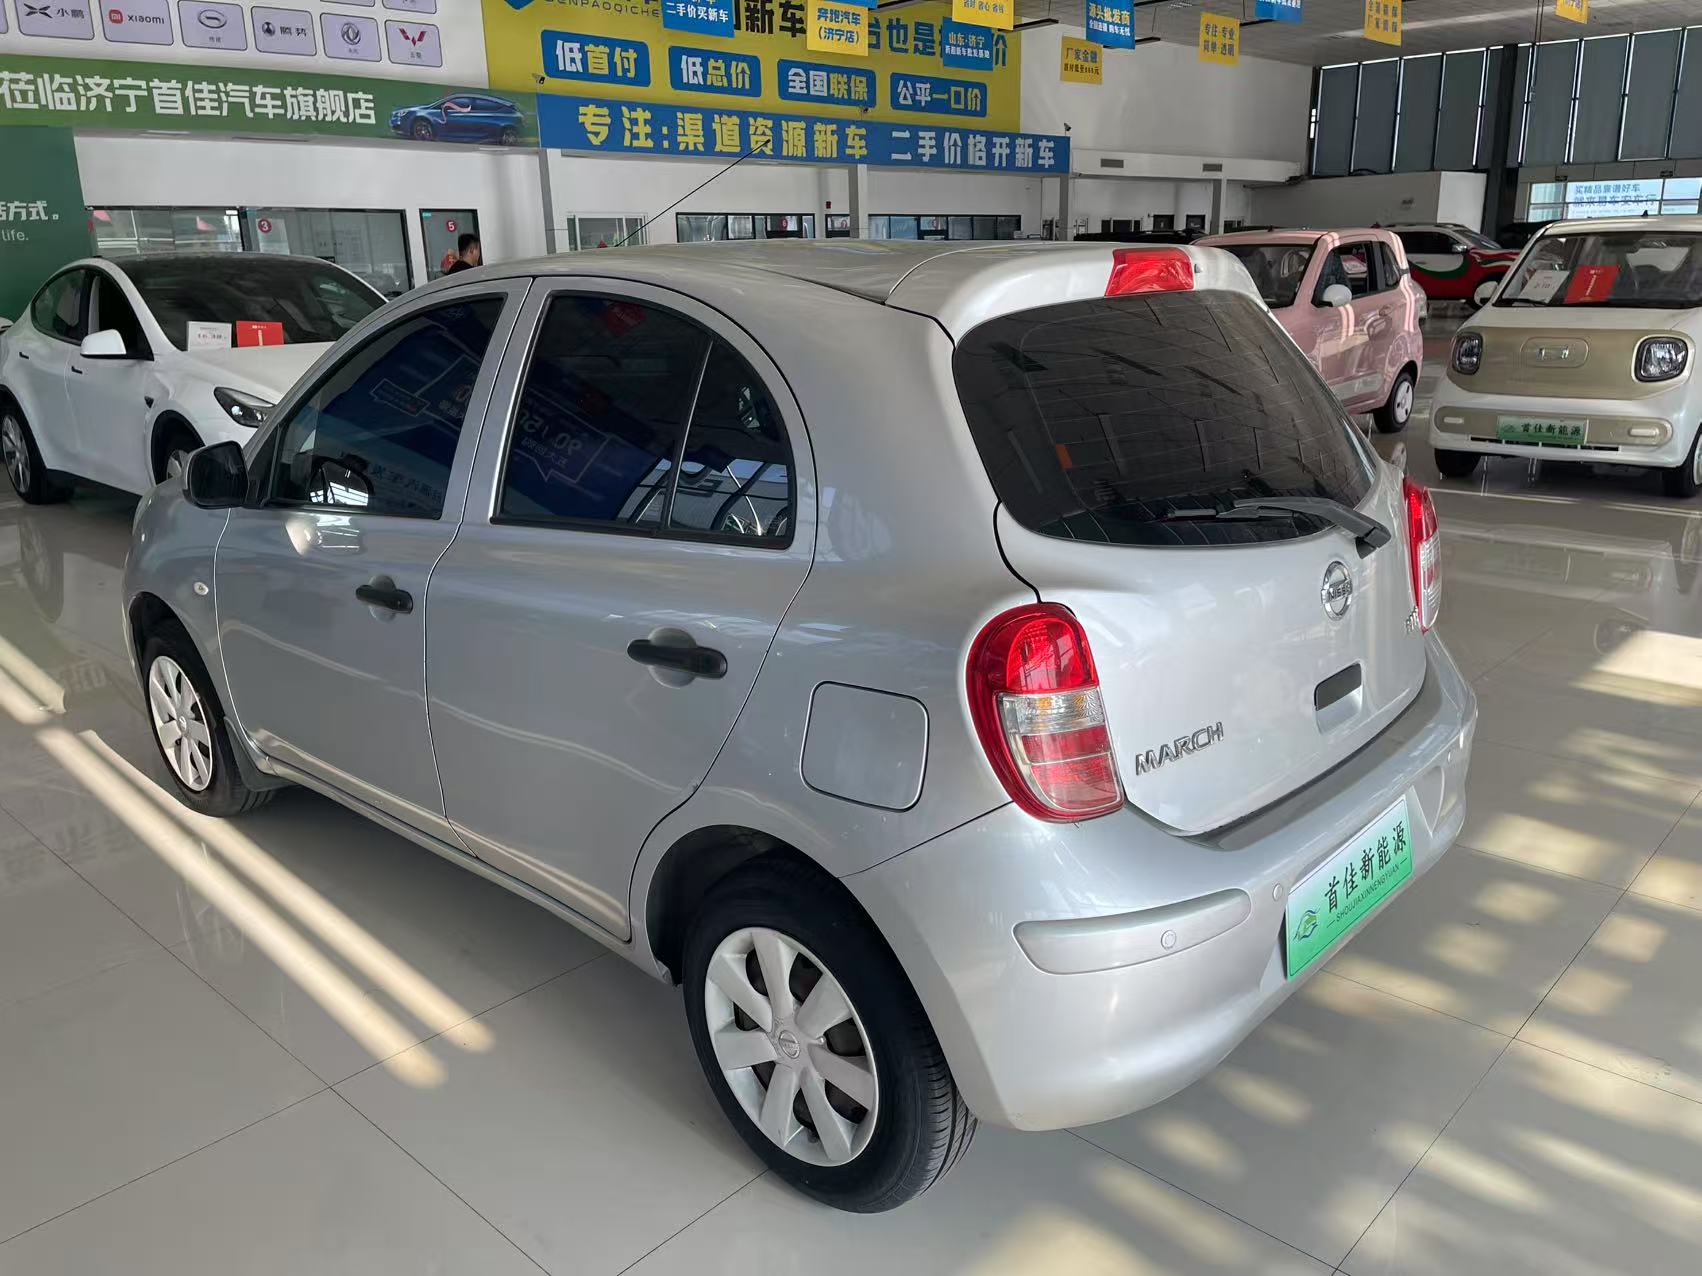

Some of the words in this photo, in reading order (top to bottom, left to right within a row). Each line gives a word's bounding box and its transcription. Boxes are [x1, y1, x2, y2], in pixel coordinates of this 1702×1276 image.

[56, 8, 85, 19] 小鹏
[666, 2, 729, 23] 二手价买新车
[817, 7, 861, 26] 奔跑汽车
[556, 39, 637, 78] 低首付
[681, 55, 750, 90] 低总价
[0, 71, 376, 125] 莅临济宁首佳汽车旗舰店
[788, 67, 868, 101] 全国联保
[897, 80, 982, 112] 公平一口价
[891, 131, 1055, 168] 二手价格开新车
[261, 221, 270, 231] 3
[447, 222, 455, 231] 5
[1135, 721, 1224, 777] MARCH
[1324, 820, 1407, 913] 首佳新能源
